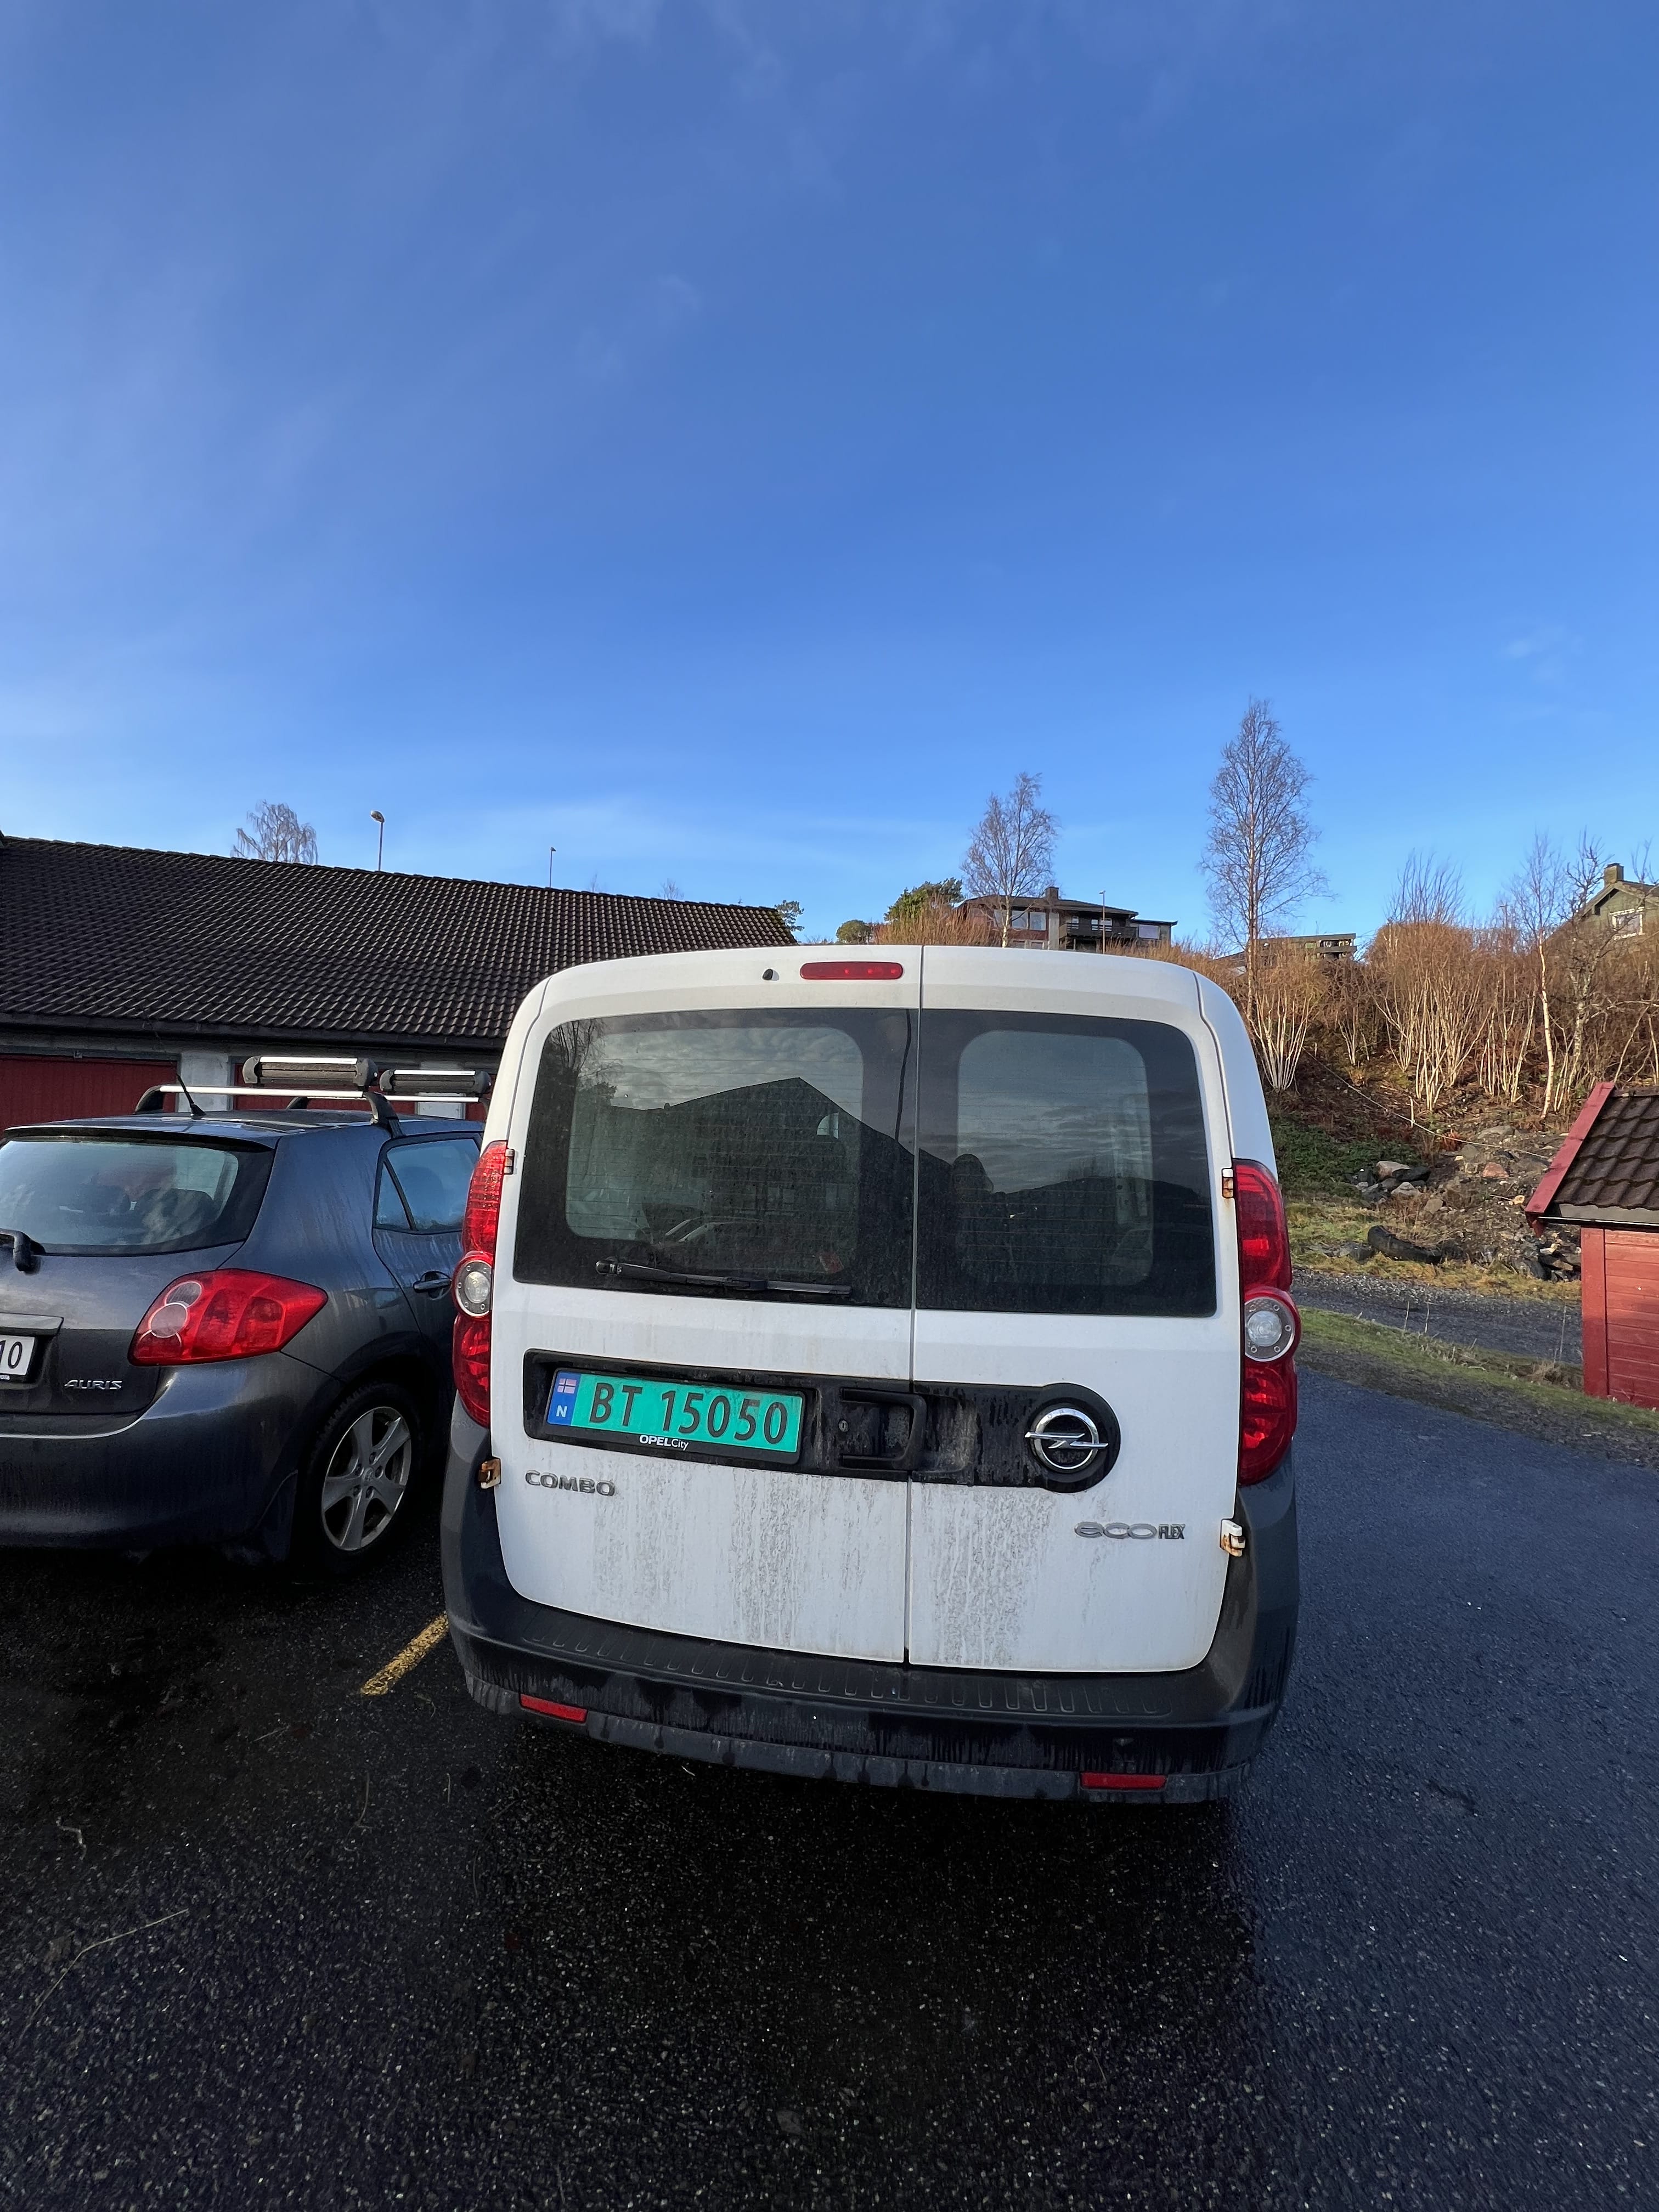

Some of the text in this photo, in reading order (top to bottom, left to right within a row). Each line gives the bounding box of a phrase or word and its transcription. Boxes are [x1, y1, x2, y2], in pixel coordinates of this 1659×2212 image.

[64, 1380, 122, 1390] AURIS
[556, 1405, 567, 1418] N
[589, 1382, 787, 1444] BT 15050
[525, 1470, 616, 1497] COMBO
